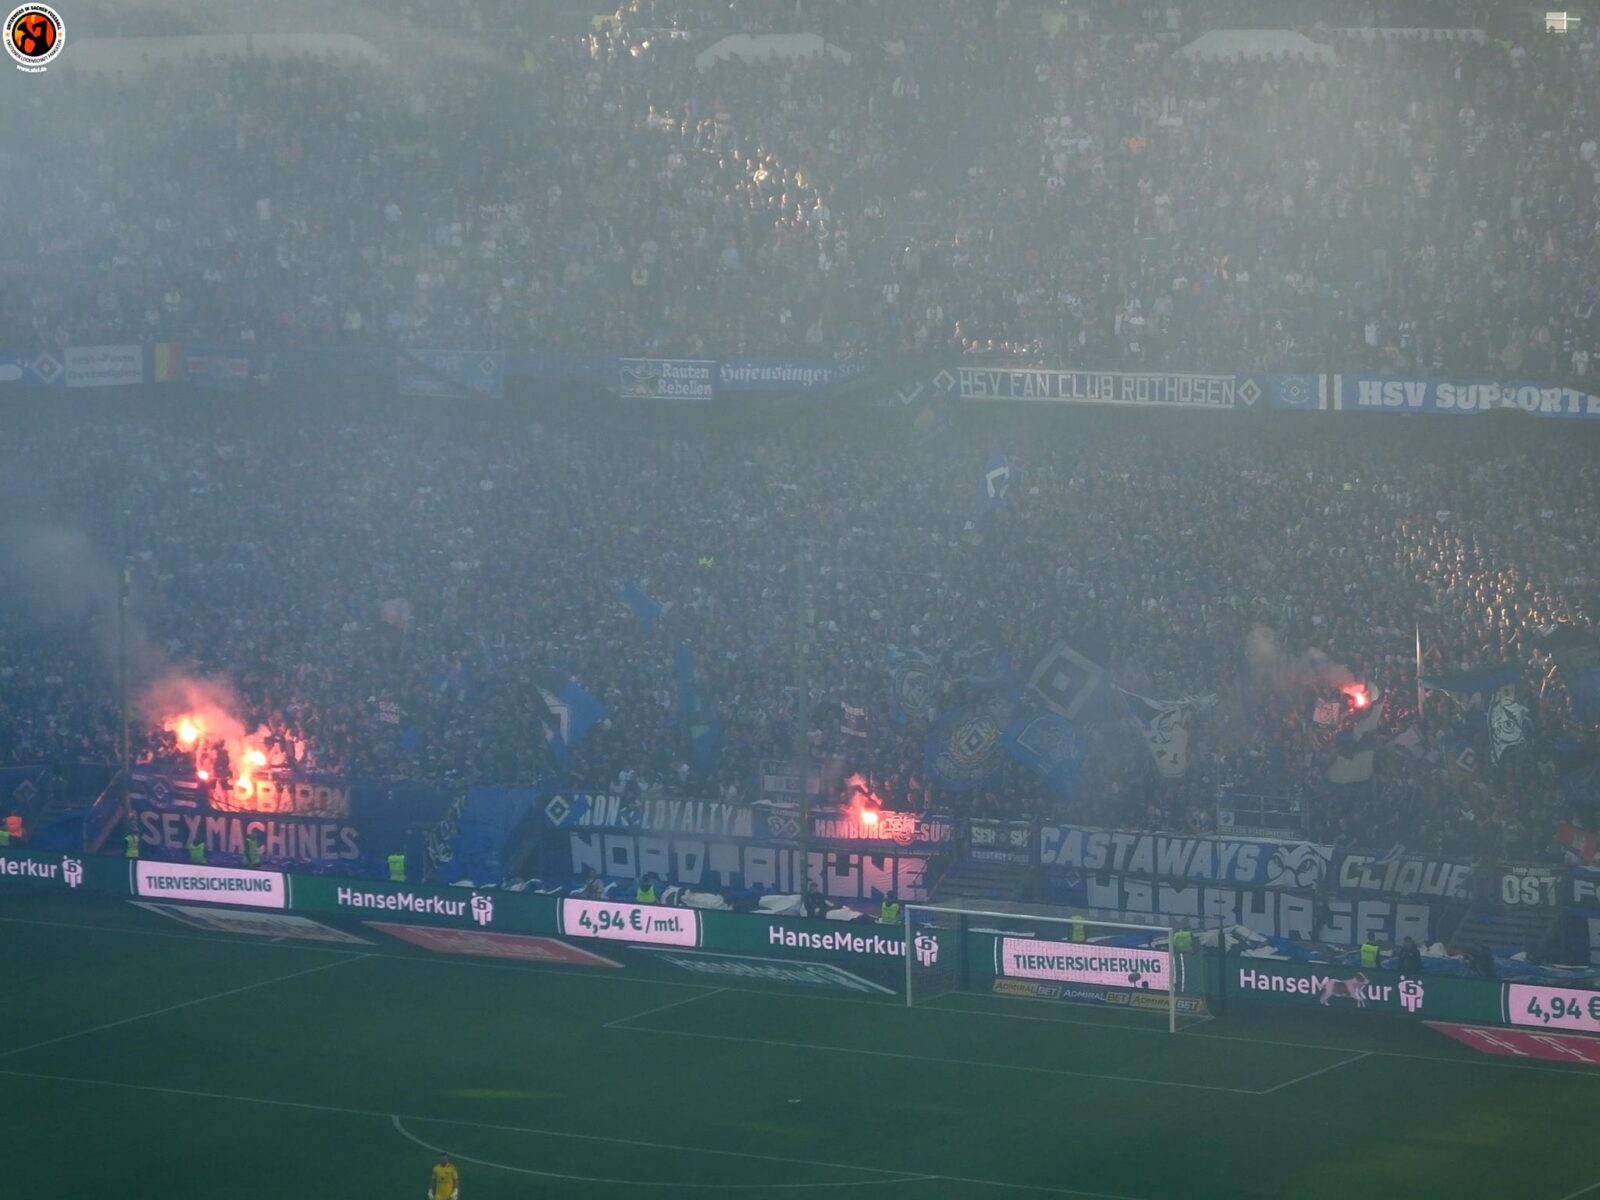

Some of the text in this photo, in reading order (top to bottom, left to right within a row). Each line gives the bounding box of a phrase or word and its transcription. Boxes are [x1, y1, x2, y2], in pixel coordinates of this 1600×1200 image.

[662, 363, 709, 379] Rauten
[657, 379, 712, 396] Rebellen
[962, 371, 1235, 405] HSV FAN CLUB ROTHOSEN
[1358, 380, 1427, 407] HSV
[1040, 826, 1261, 881] CASTAWAYS
[146, 875, 274, 893] TIERVERSICHERUNG
[337, 886, 467, 917] HanseMerkur
[578, 909, 626, 935] 4,94
[1013, 953, 1162, 975] TIERVERSICHERUNG
[1527, 995, 1583, 1024] 4,94
